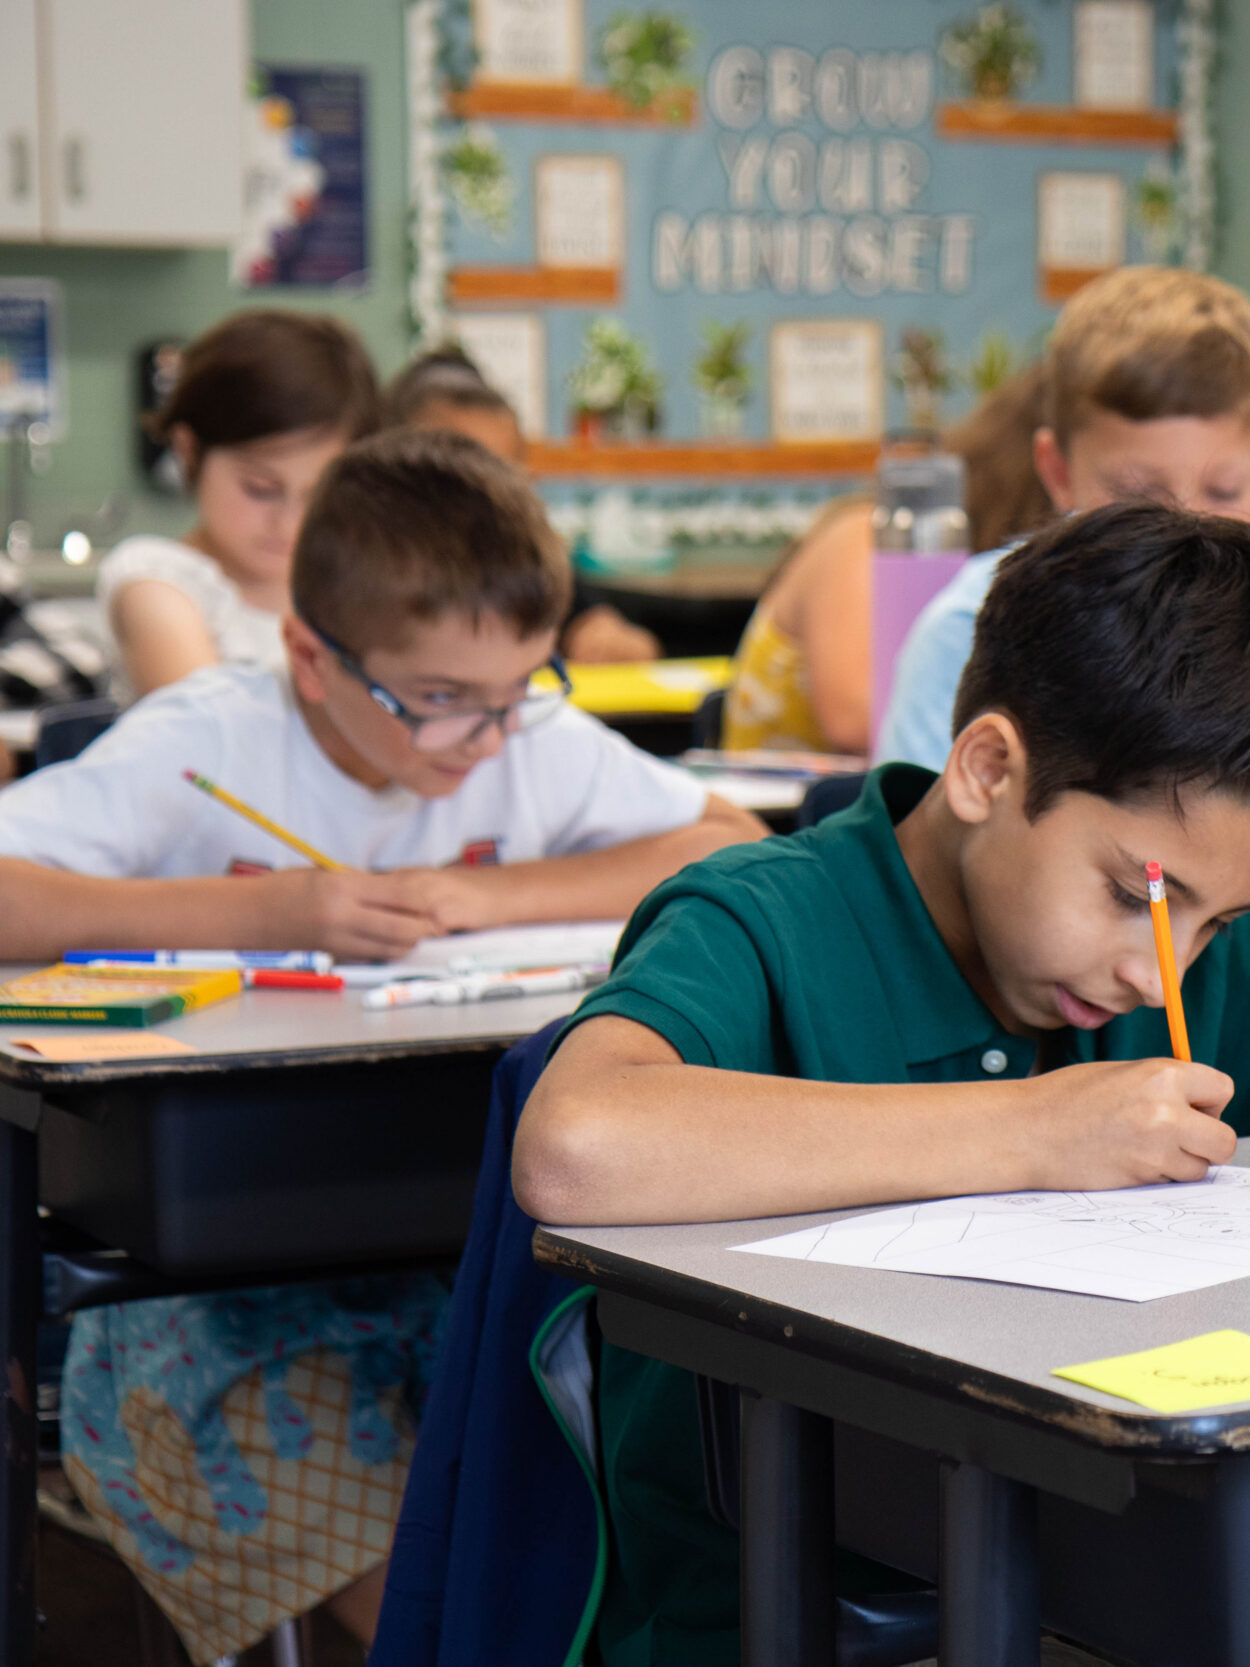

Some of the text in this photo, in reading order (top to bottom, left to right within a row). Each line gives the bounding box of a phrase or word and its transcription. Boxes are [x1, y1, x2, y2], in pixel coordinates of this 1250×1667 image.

[708, 46, 932, 130] GROW
[715, 132, 929, 213] YOUR
[653, 211, 975, 296] MINDSET
